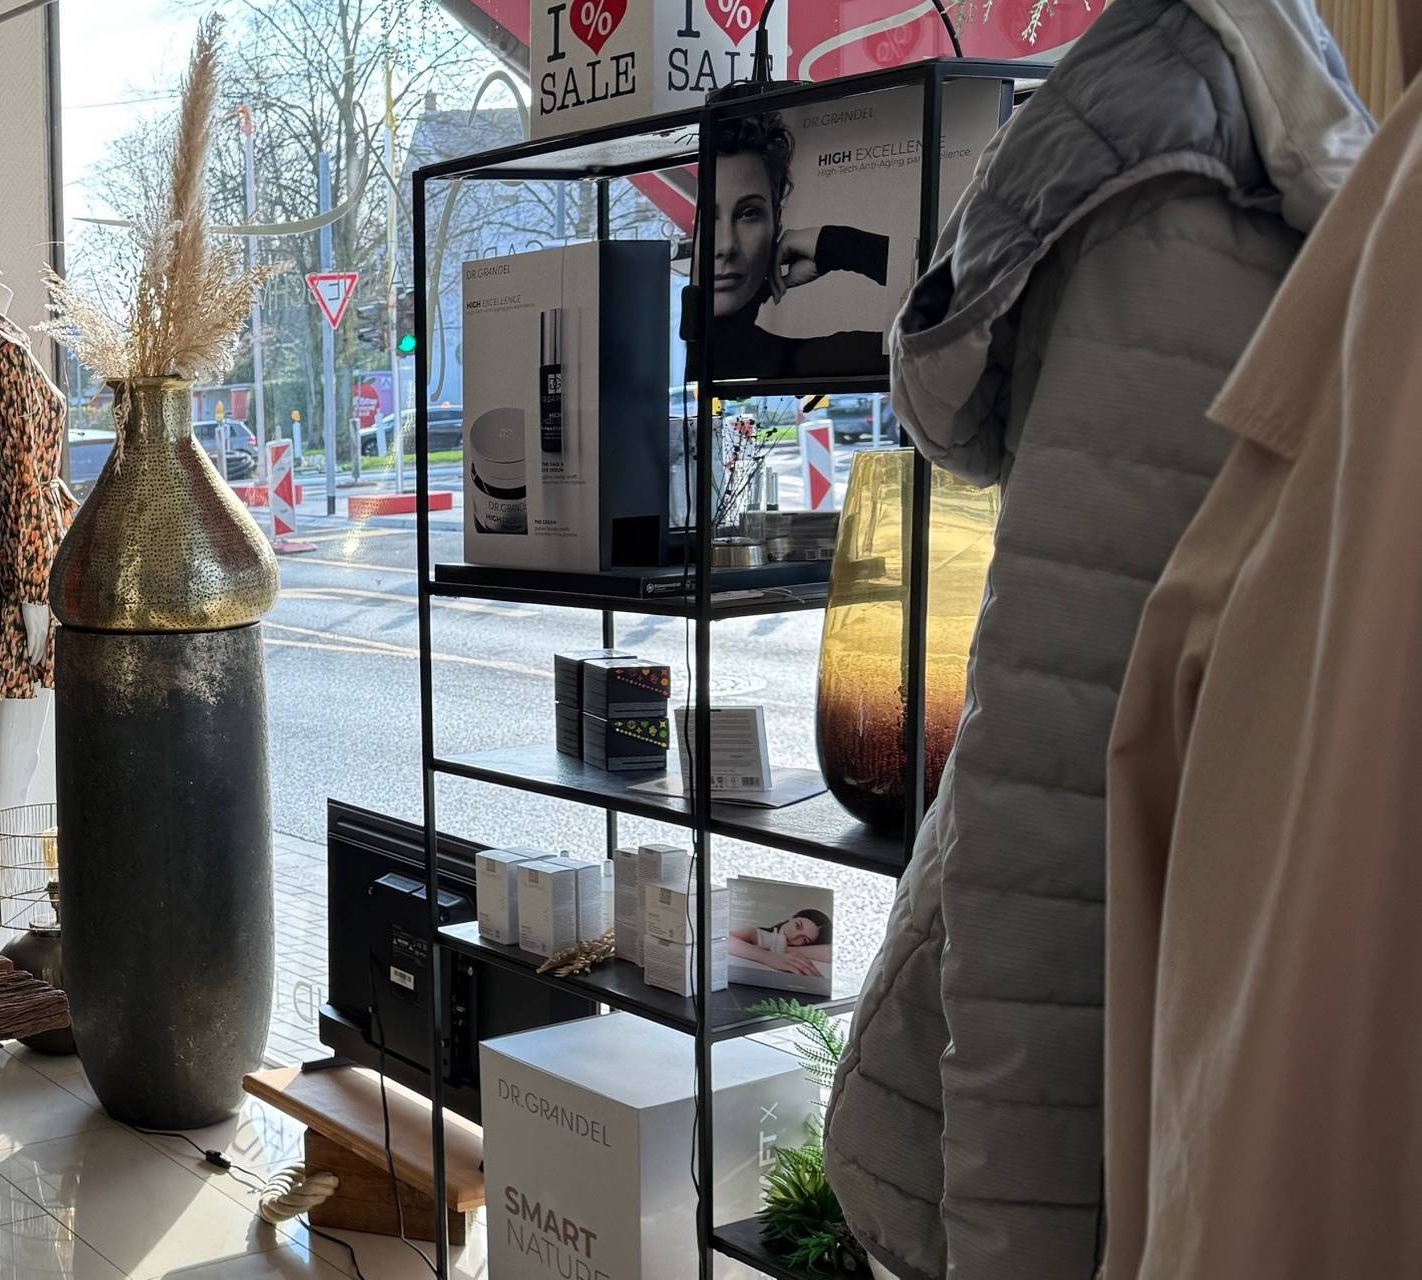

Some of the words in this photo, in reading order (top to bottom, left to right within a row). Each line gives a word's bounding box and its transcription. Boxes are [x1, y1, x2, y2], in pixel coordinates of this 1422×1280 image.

[547, 3, 566, 63] I
[677, 0, 700, 38] I
[540, 51, 636, 116] SALE
[818, 150, 852, 167] HIGH
[856, 135, 946, 161] EXCELLENE
[498, 1078, 611, 1148] DR.GRANDEL
[505, 1185, 597, 1259] SMART
